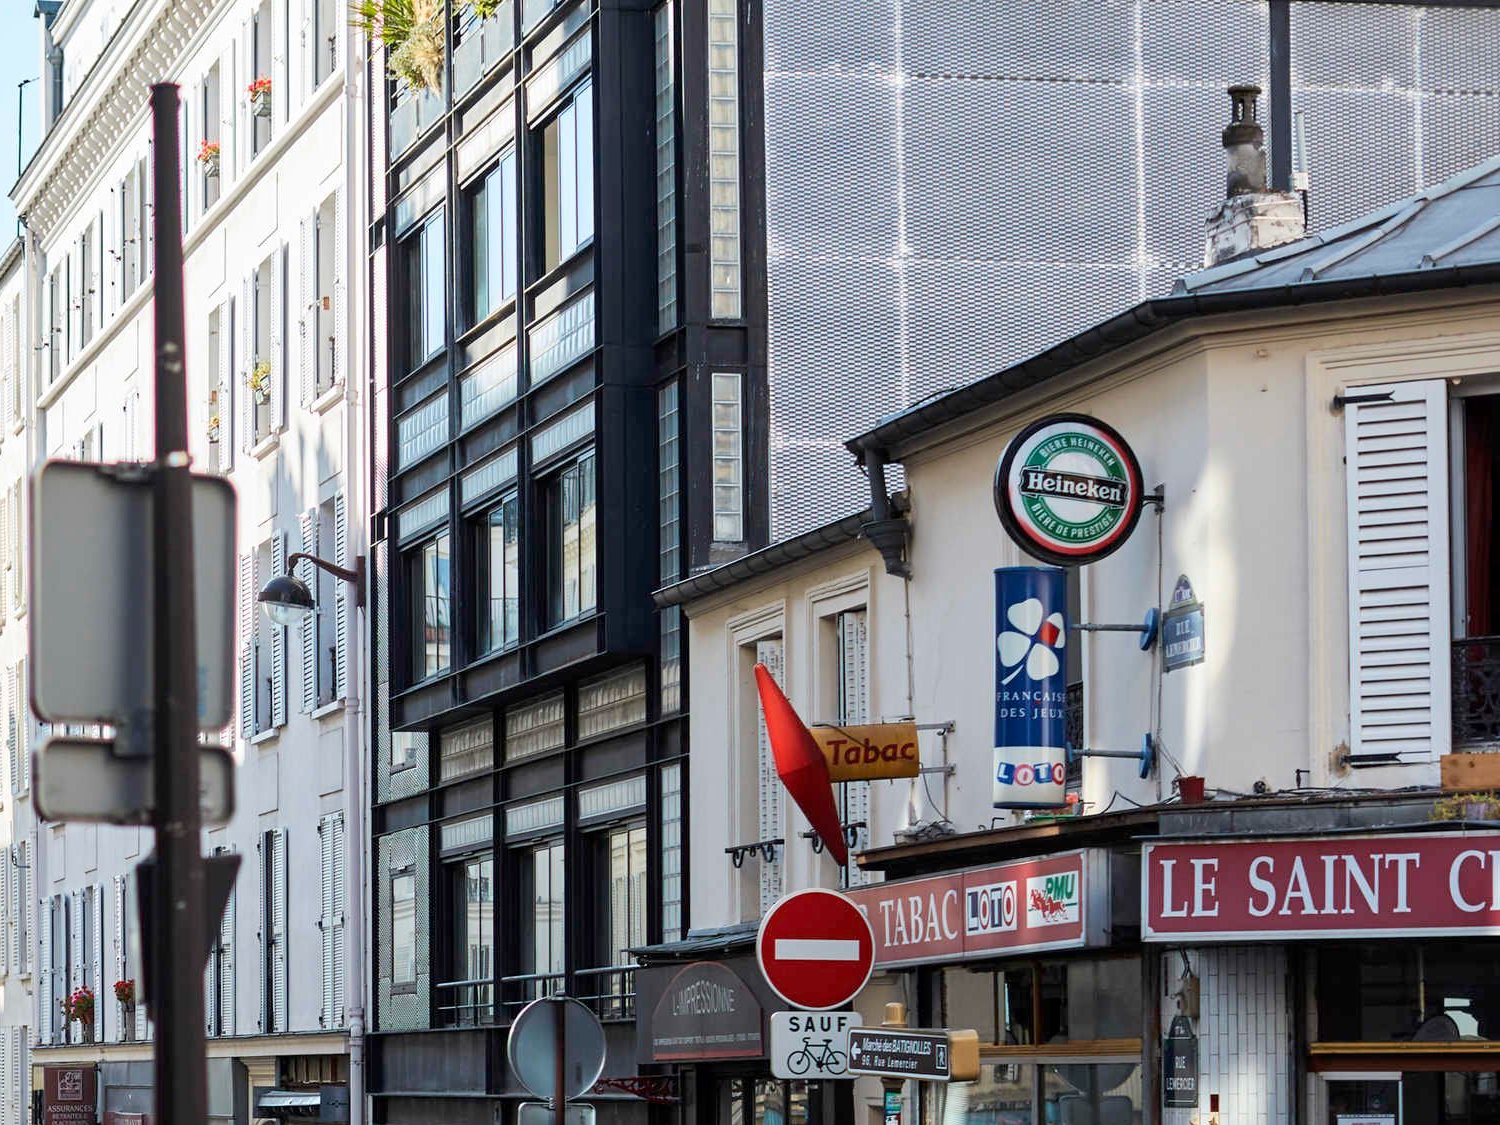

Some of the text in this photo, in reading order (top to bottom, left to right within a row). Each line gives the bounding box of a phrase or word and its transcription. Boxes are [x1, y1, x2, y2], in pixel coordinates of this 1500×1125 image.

[1039, 437, 1117, 466] BIERE HEINEKEN
[1027, 472, 1121, 502] Heineken
[1030, 504, 1114, 538] BIERE DE PRESTIGE
[1000, 708, 1064, 719] DES JEUX
[826, 738, 915, 765] Tabac
[996, 762, 1065, 786] LOTO
[1045, 873, 1075, 901] PMU
[1160, 858, 1219, 918] LE
[1248, 852, 1420, 917] SAINT
[879, 889, 958, 947] TABAC
[967, 885, 1016, 931] LOTO
[789, 1016, 848, 1032] SAUF
[862, 1038, 931, 1055] Marché des BATIGNOLLES
[874, 1056, 885, 1067] Rue
[887, 1056, 918, 1070] Lemercier
[1174, 1055, 1186, 1069] RUE
[47, 1104, 93, 1113] ASSURANCES
